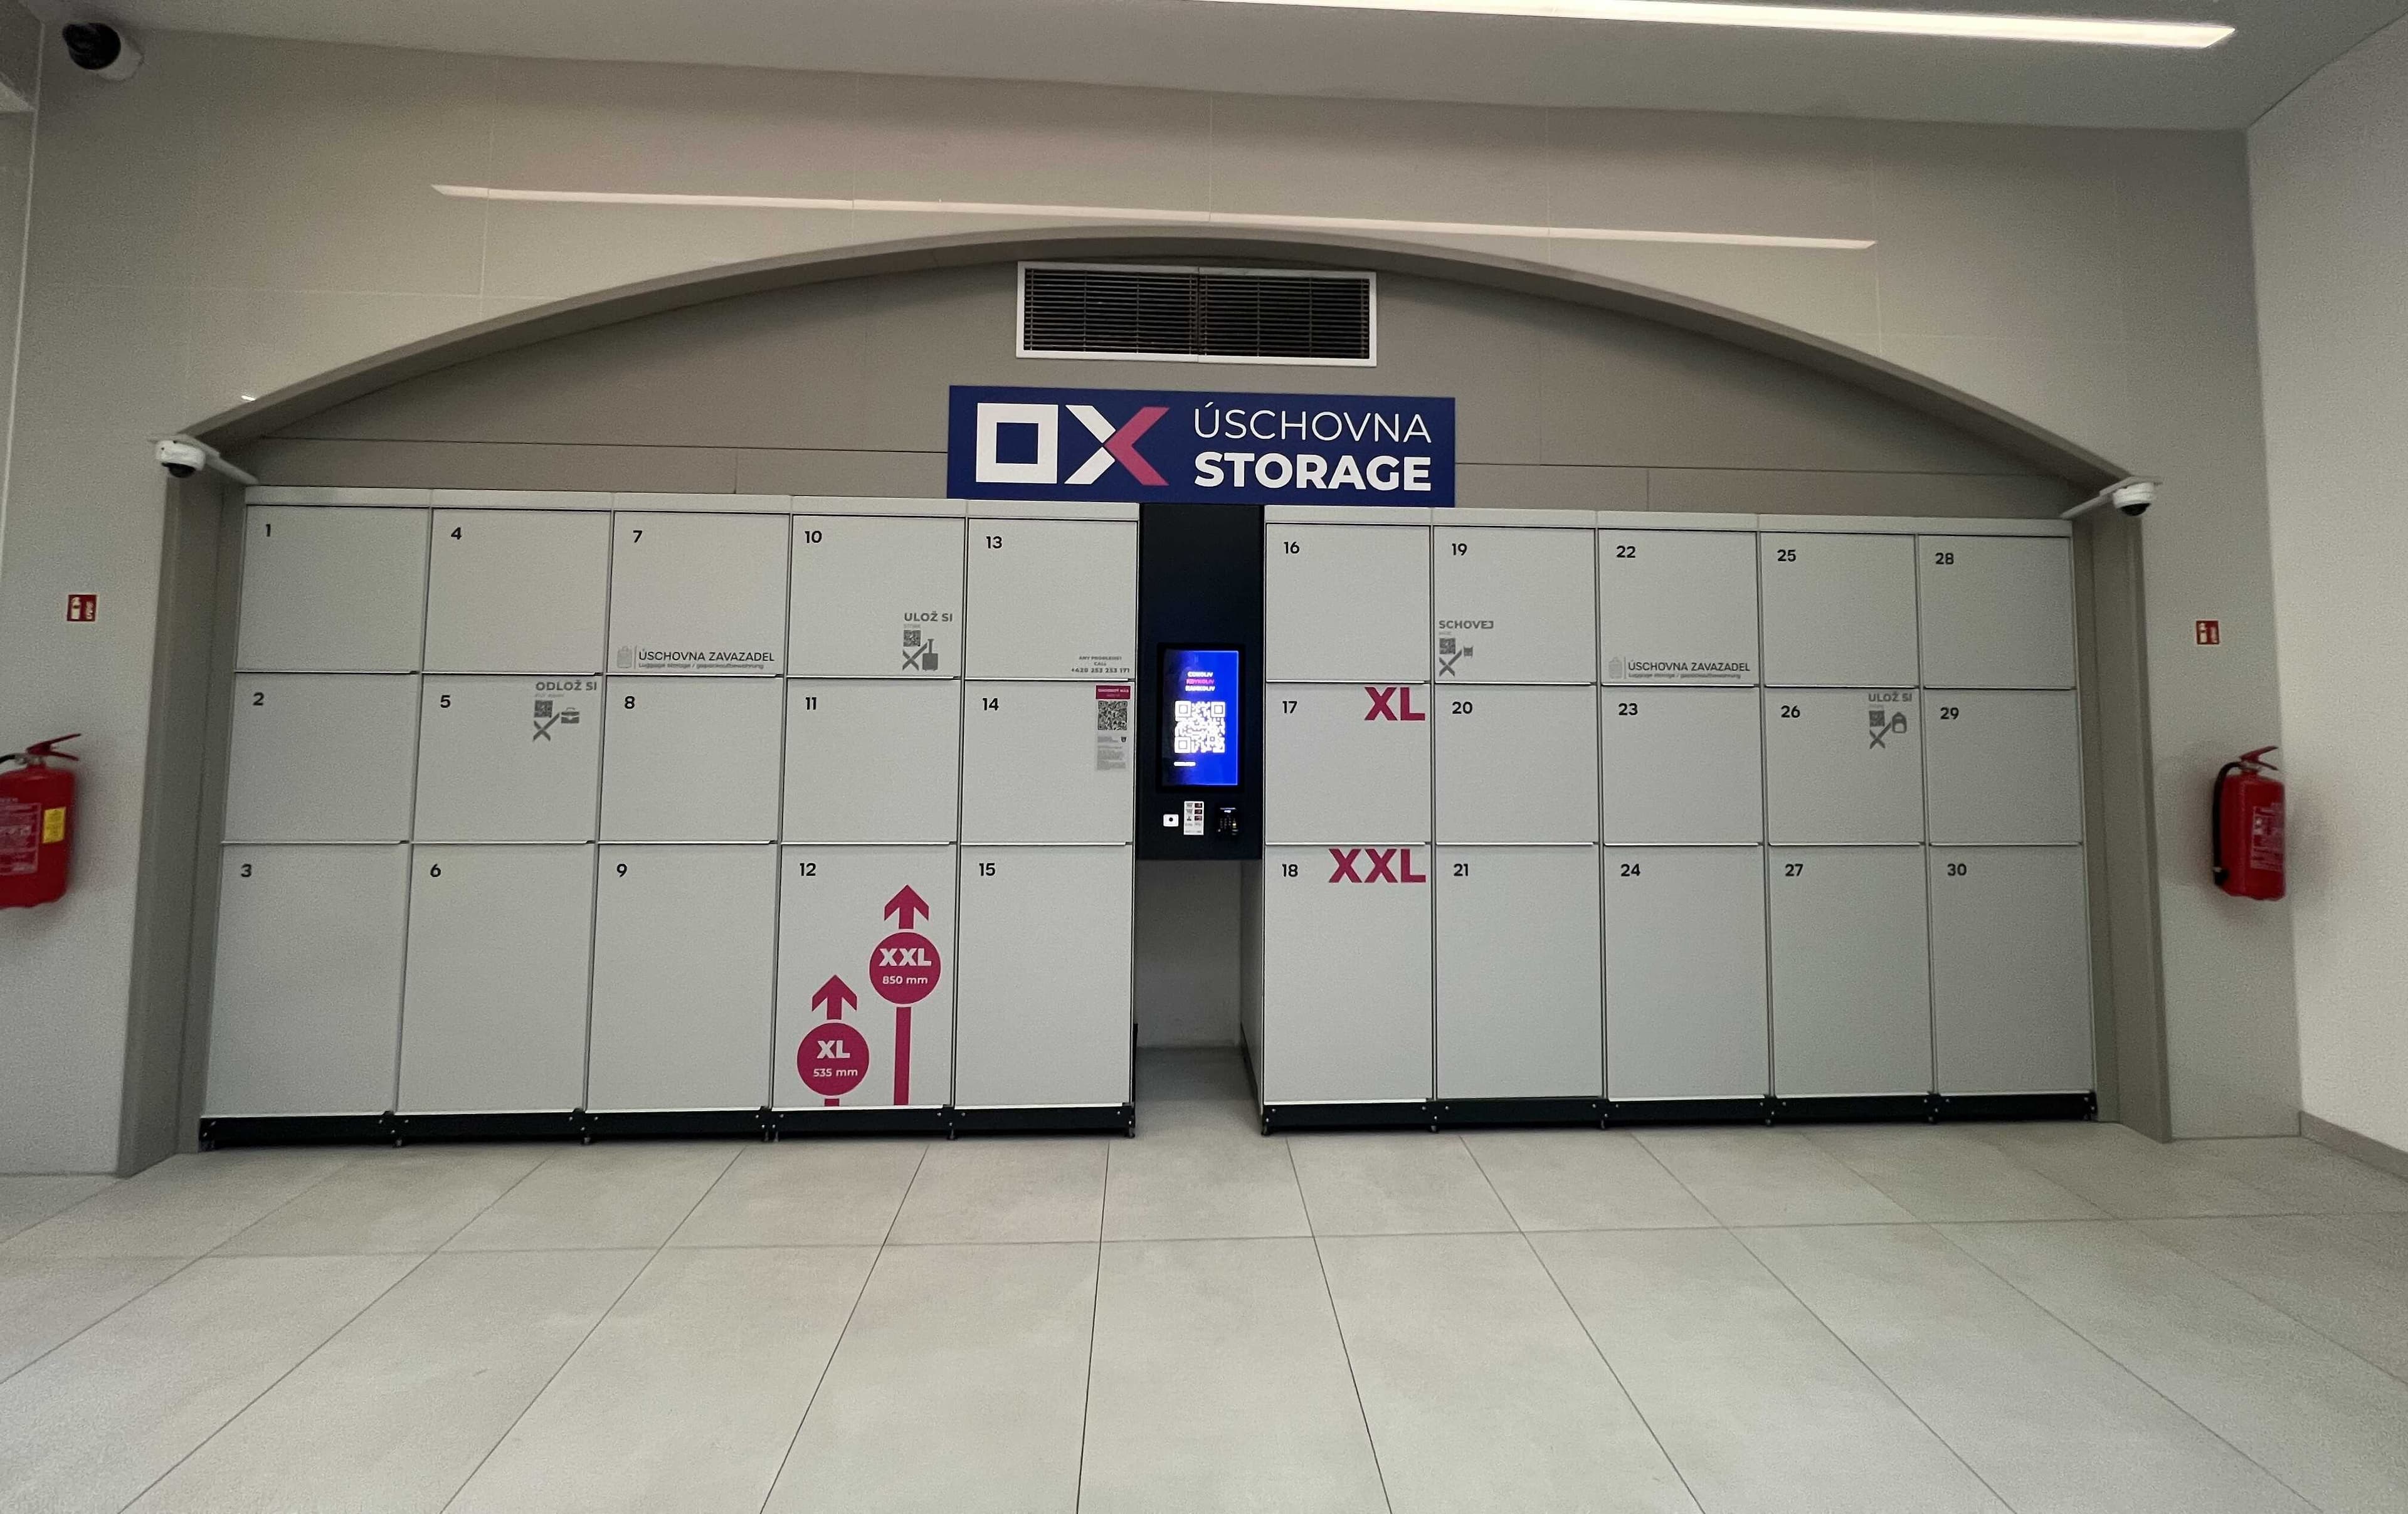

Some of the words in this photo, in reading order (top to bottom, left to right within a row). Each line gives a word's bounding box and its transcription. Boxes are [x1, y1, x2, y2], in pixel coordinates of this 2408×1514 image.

[1193, 401, 1432, 443] ÚSCHOVNA
[1193, 451, 1432, 491] STORAGE
[265, 523, 271, 537] 1
[450, 527, 462, 540] 4
[633, 530, 643, 543] 7
[805, 530, 822, 544] 10
[986, 535, 1002, 549] 13
[1284, 541, 1300, 554] 16
[1452, 543, 1467, 556] 19
[1616, 545, 1636, 559] 22
[1777, 549, 1797, 562] 25
[1935, 552, 1954, 565] 28
[904, 611, 939, 622] ULOŽ
[941, 612, 953, 623] SI
[1439, 619, 1494, 629] SCHOVEJ
[638, 648, 705, 661] ÚSCHOVNA
[708, 651, 775, 662] ZAVAZADEL
[1628, 660, 1689, 671] ÚSCHOVNA
[1691, 661, 1751, 672] ZAVAZADEL
[535, 679, 583, 691] ODLOŽ
[586, 681, 598, 691] SI
[253, 692, 264, 706] 2
[440, 695, 451, 708] 5
[624, 695, 635, 709] 8
[805, 697, 817, 710] 11
[1902, 692, 1913, 702] SI
[982, 697, 999, 711] 14
[1282, 700, 1297, 714] 17
[1364, 686, 1426, 722] XL
[1452, 701, 1473, 715] 20
[1618, 703, 1638, 716] 23
[1781, 705, 1800, 718] 26
[1940, 707, 1959, 720] 29
[240, 863, 251, 878] 3
[430, 863, 441, 878] 6
[616, 863, 628, 878] 9
[800, 863, 816, 876] 12
[979, 863, 996, 876] 15
[1282, 864, 1298, 878] 18
[1328, 848, 1427, 884] XXL
[1454, 863, 1469, 876] 21
[1620, 863, 1641, 877] 24
[1785, 863, 1803, 876] 27
[1947, 863, 1967, 876] 30
[879, 947, 932, 967] XXL
[882, 975, 903, 985] 850
[906, 976, 928, 985] mm
[816, 1039, 851, 1059] XL
[813, 1068, 833, 1078] 535
[836, 1068, 858, 1077] mm
